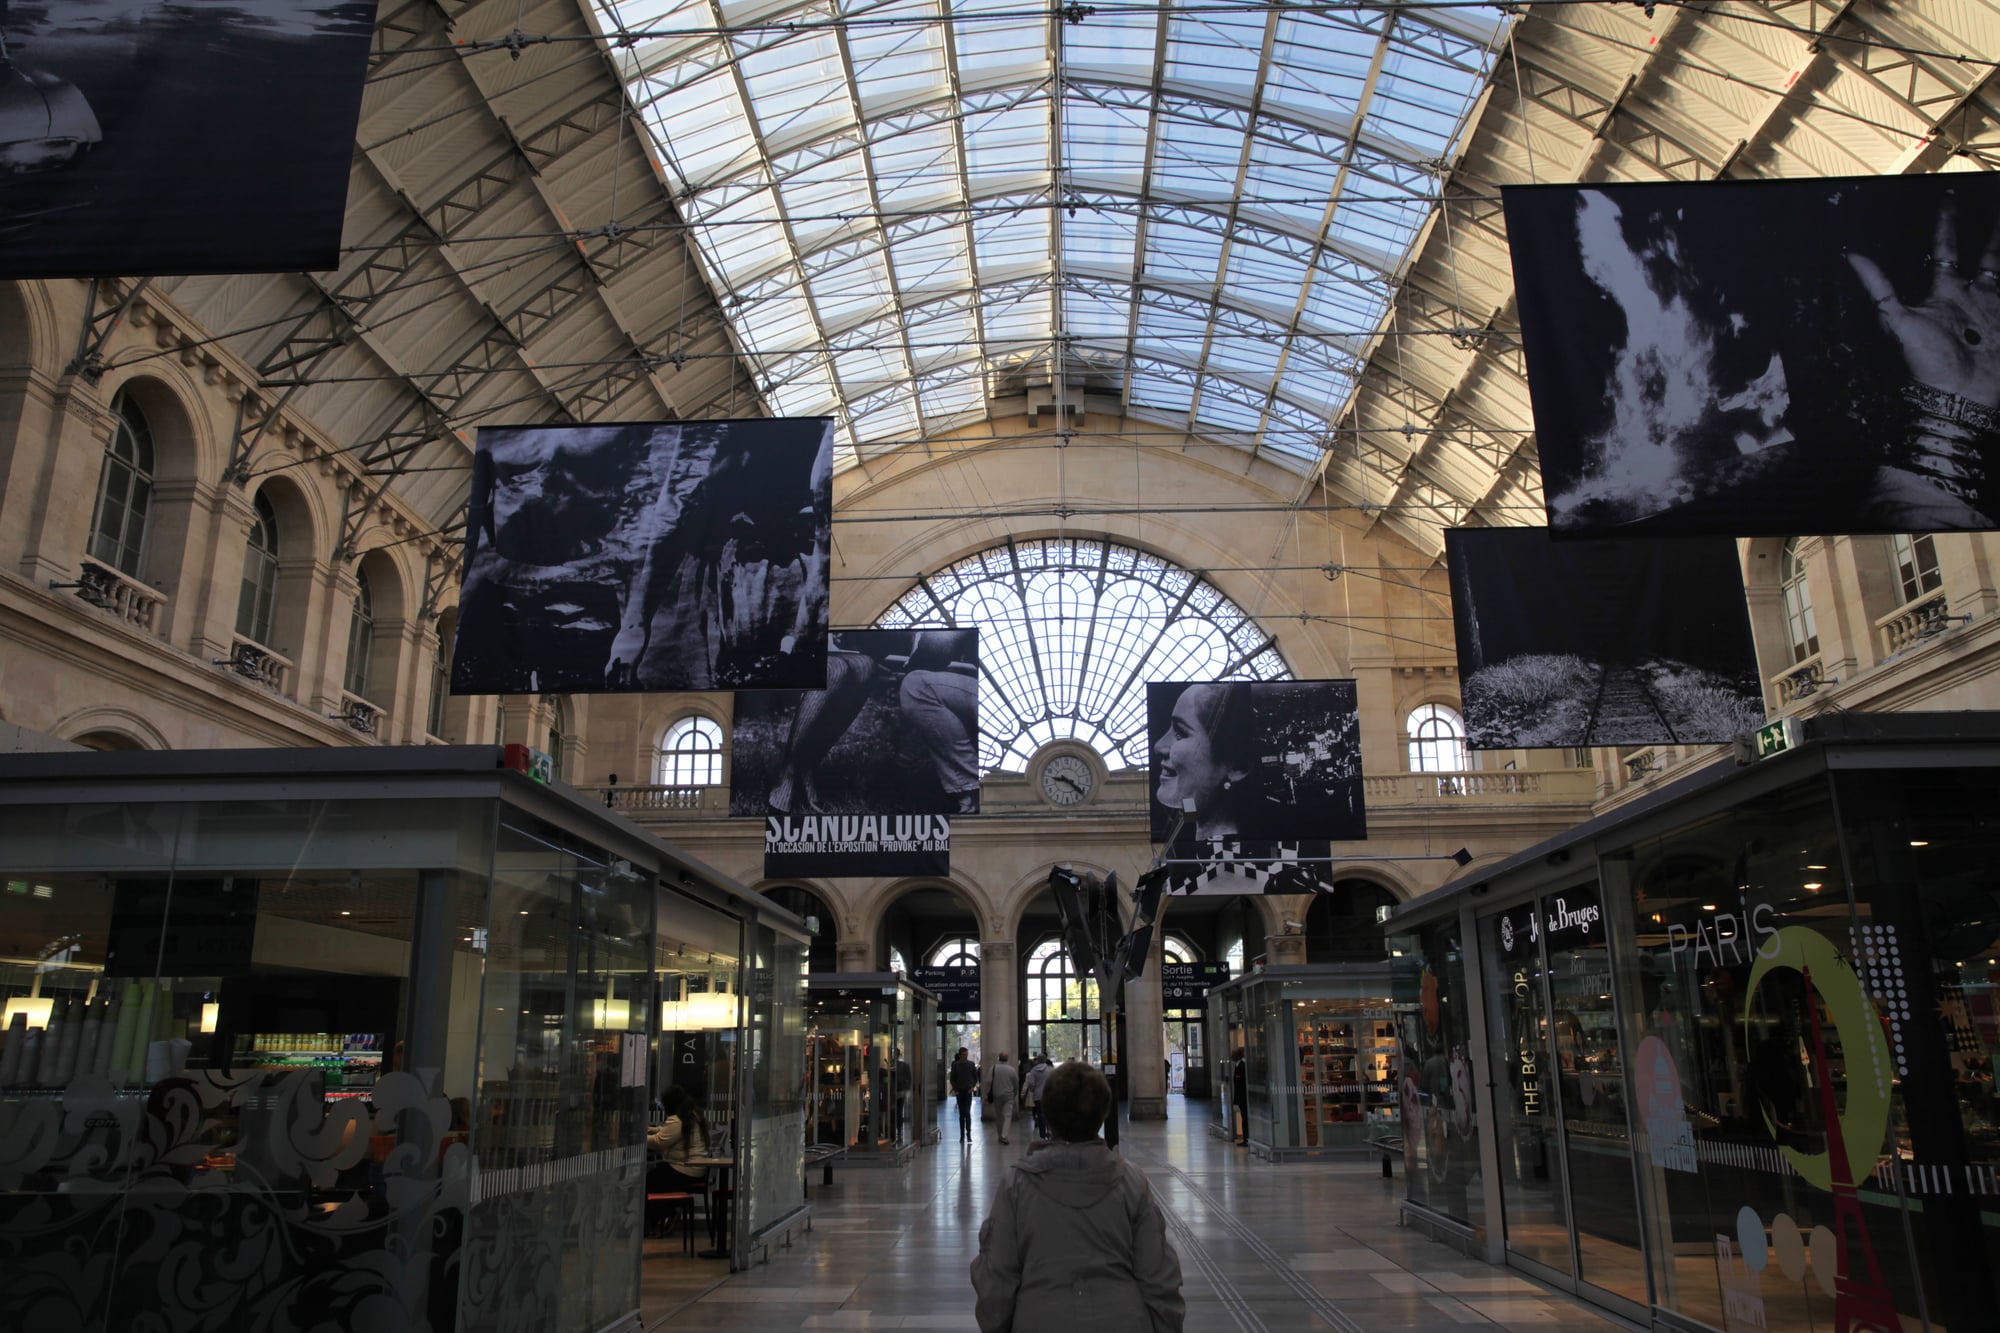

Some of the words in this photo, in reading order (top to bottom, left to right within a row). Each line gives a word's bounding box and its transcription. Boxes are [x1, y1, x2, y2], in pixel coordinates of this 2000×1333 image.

[765, 815, 950, 842] SCANDALOUS
[772, 842, 815, 853] L'OCCASION
[817, 842, 826, 853] DE
[829, 841, 877, 853] L'EXPOSITION
[880, 840, 921, 852] "PROVOKE"
[923, 840, 933, 852] AU
[935, 840, 949, 852] BAL
[1549, 914, 1558, 932] de
[1556, 898, 1599, 934] Bruges
[1667, 903, 1782, 973] PARIS
[1162, 965, 1192, 975] Sortie
[1523, 1081, 1540, 1116] THE
